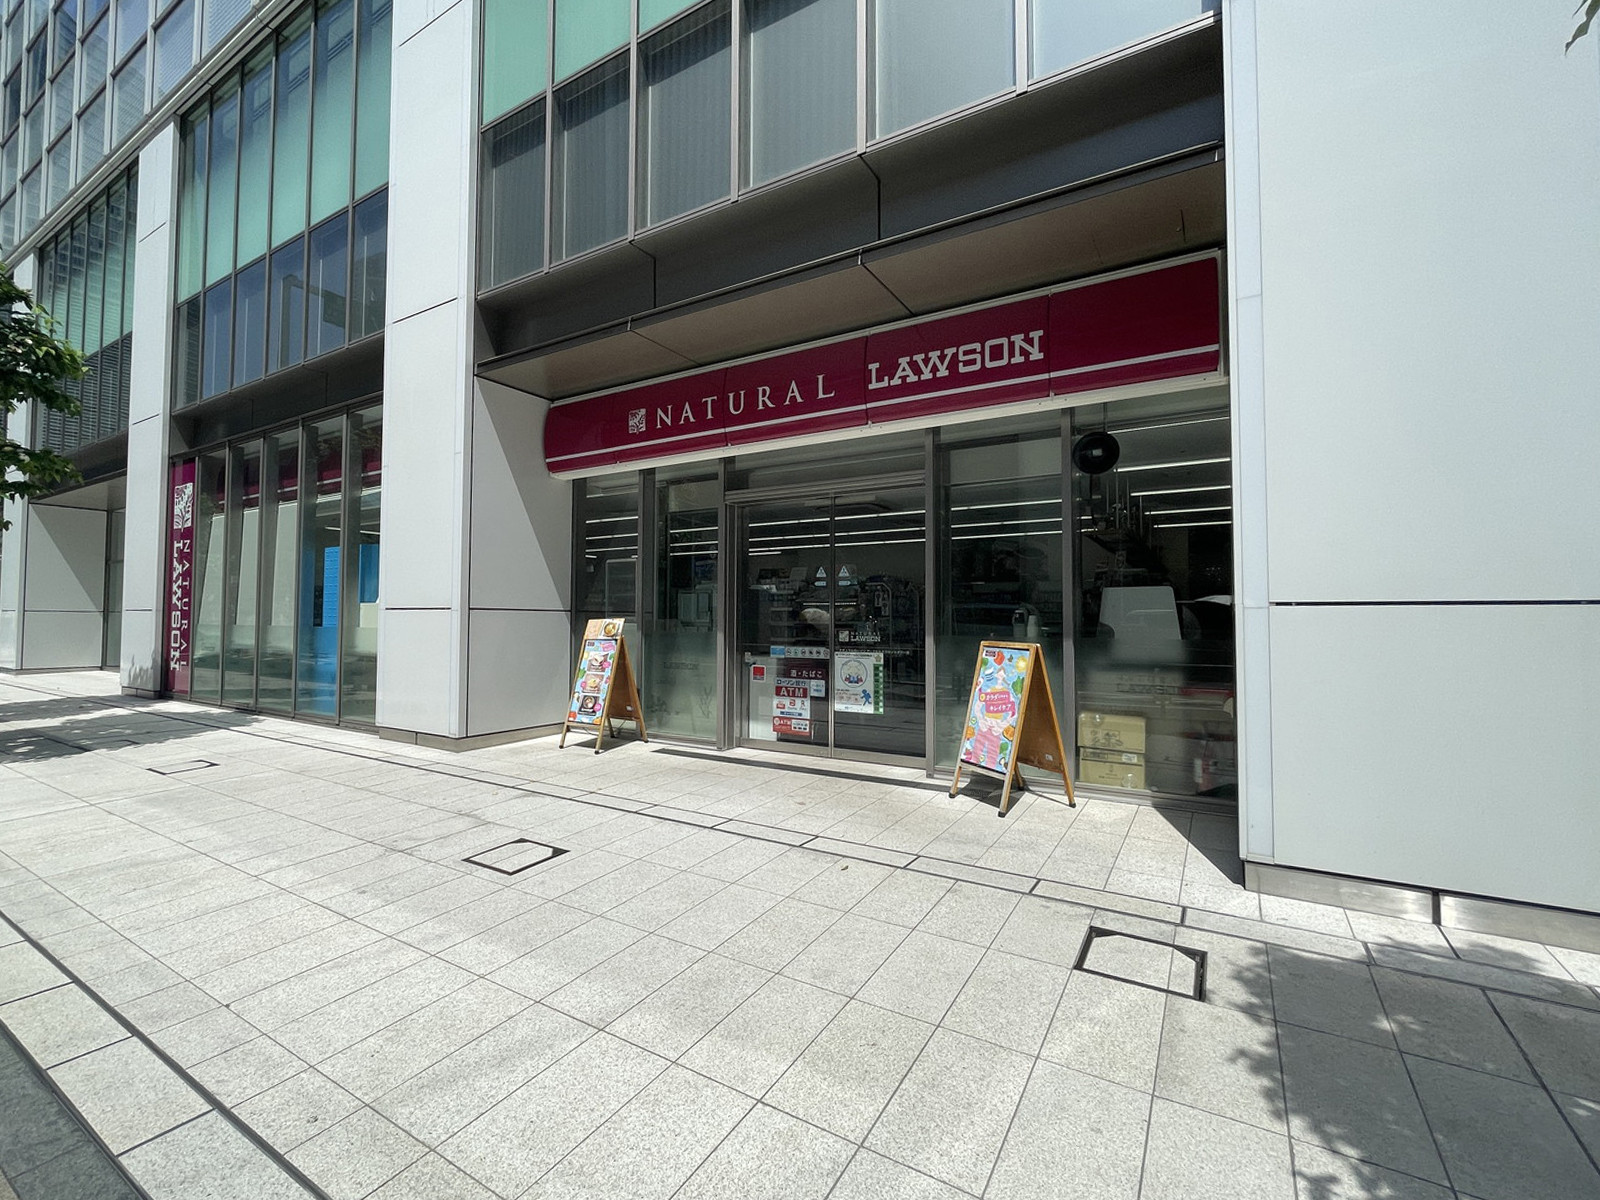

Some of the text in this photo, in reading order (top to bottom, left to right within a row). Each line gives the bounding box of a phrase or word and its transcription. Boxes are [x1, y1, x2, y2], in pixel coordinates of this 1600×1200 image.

[655, 330, 1045, 429] NATURAL LAWSON
[170, 540, 183, 671] LAWSON
[180, 540, 190, 667] NATURAL
[780, 687, 803, 697] ATM
